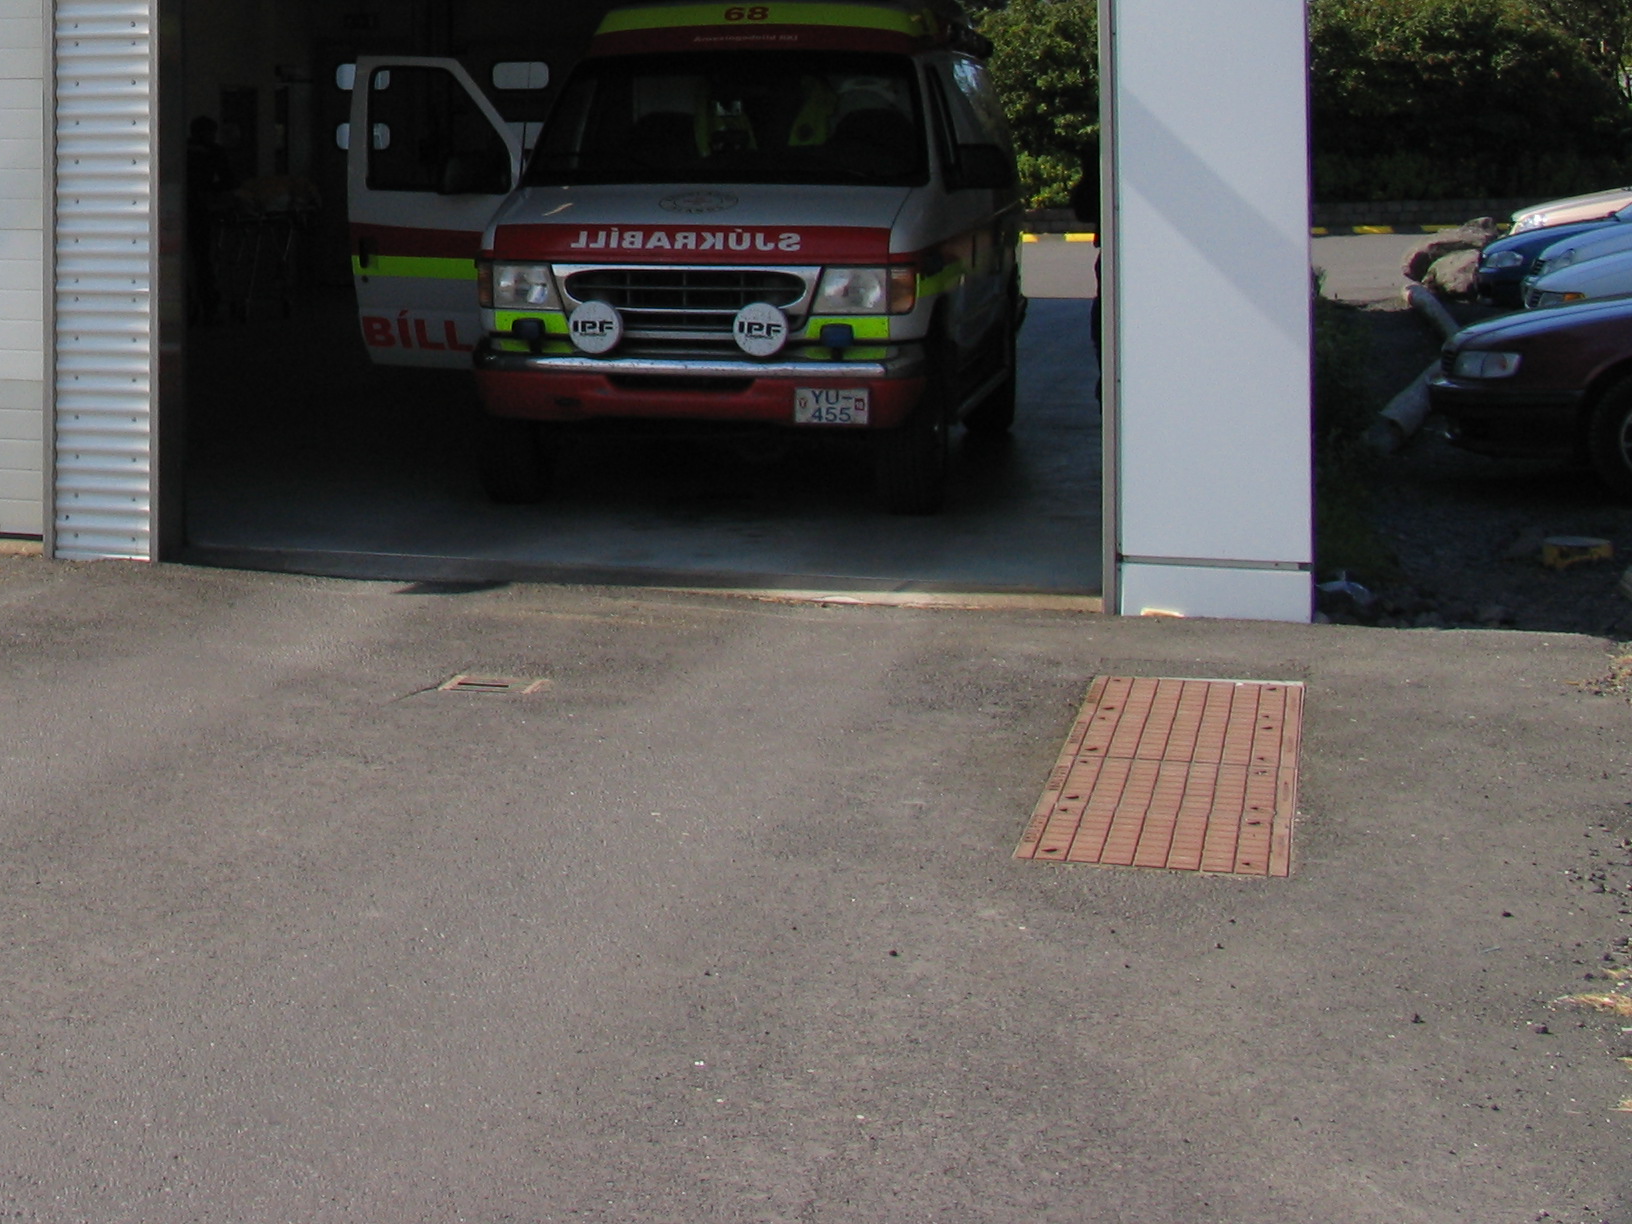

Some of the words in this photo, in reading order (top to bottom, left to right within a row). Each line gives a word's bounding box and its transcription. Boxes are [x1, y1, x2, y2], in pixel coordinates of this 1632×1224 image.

[724, 6, 770, 21] 68
[362, 308, 474, 352] BÍLL
[573, 320, 613, 333] IPF
[739, 321, 782, 336] IPF
[811, 407, 851, 422] 455
